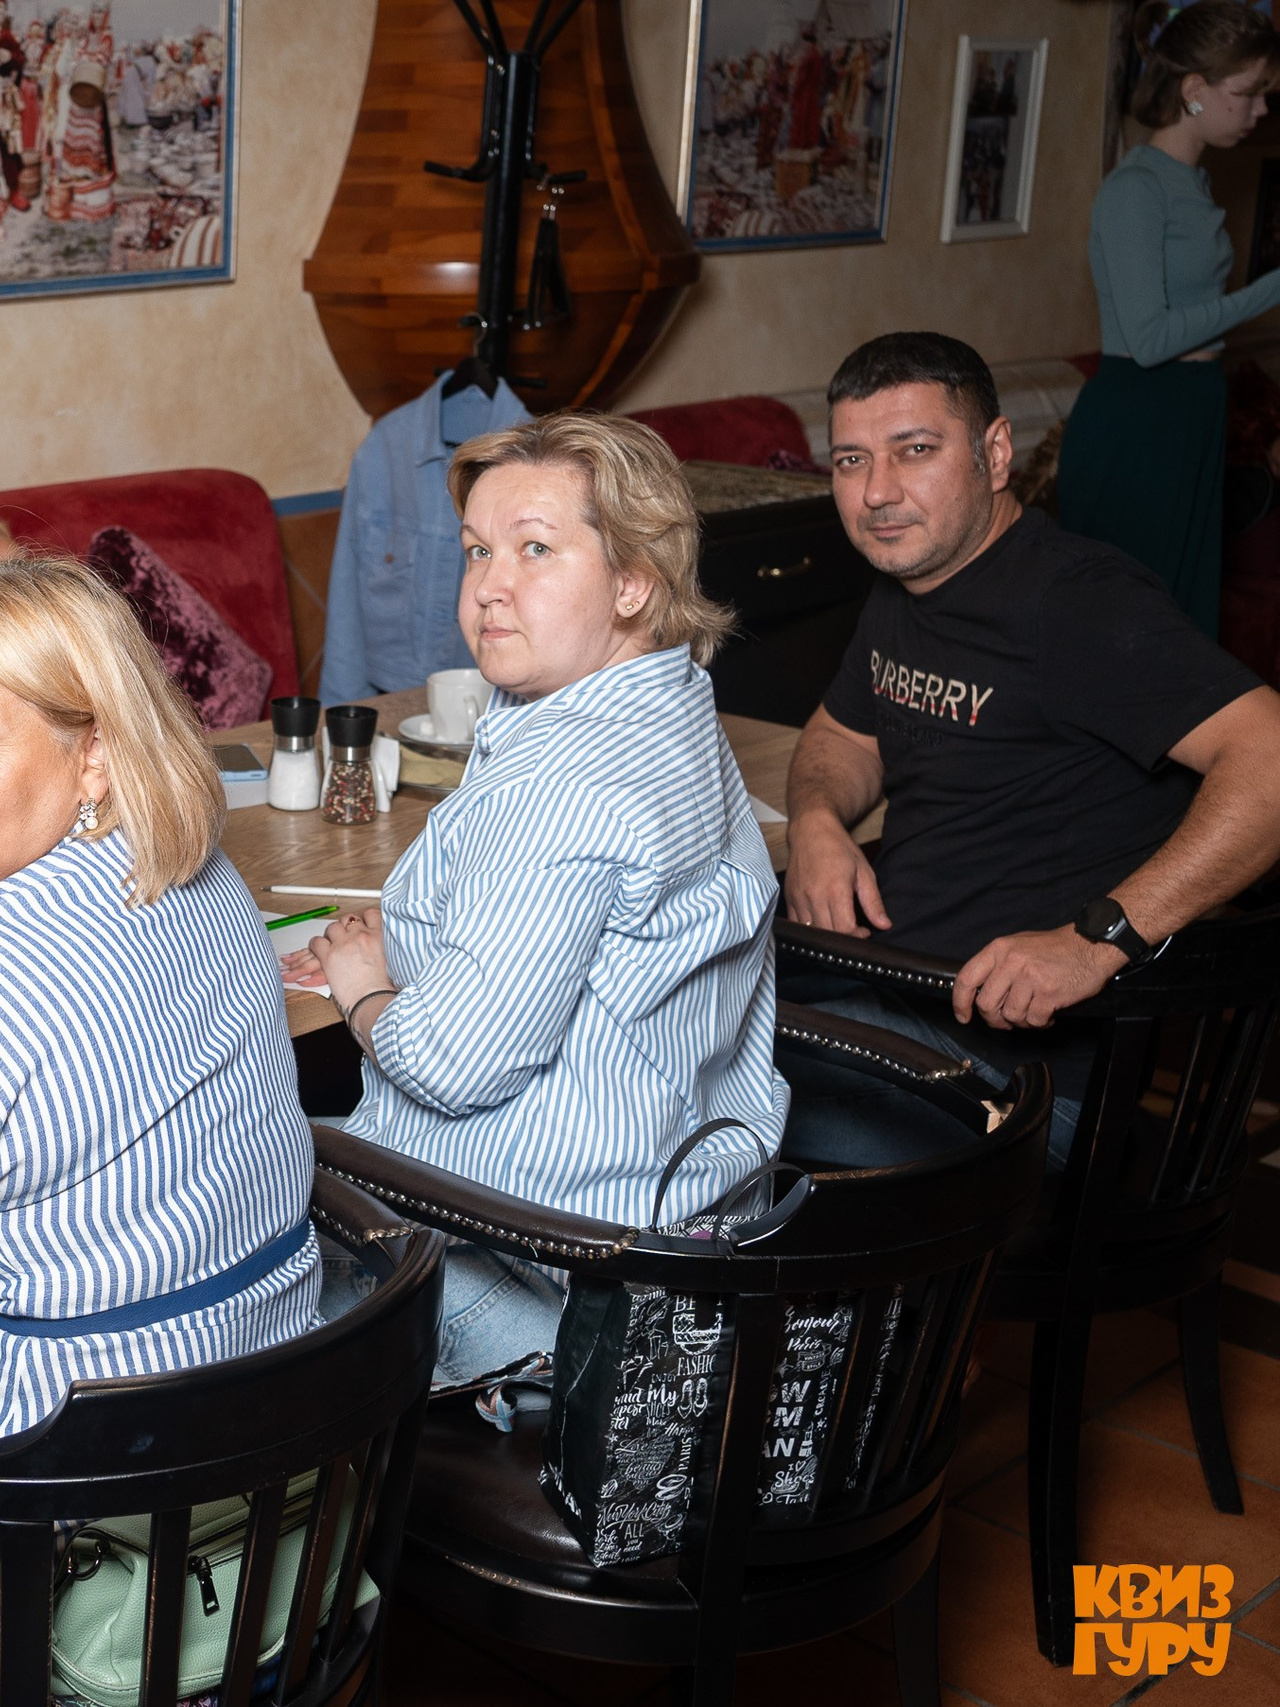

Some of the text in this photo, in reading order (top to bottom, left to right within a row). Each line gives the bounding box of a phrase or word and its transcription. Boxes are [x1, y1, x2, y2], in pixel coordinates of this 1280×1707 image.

[871, 649, 994, 727] BURBERRY
[646, 1383, 680, 1407] My
[624, 1522, 645, 1540] ALL
